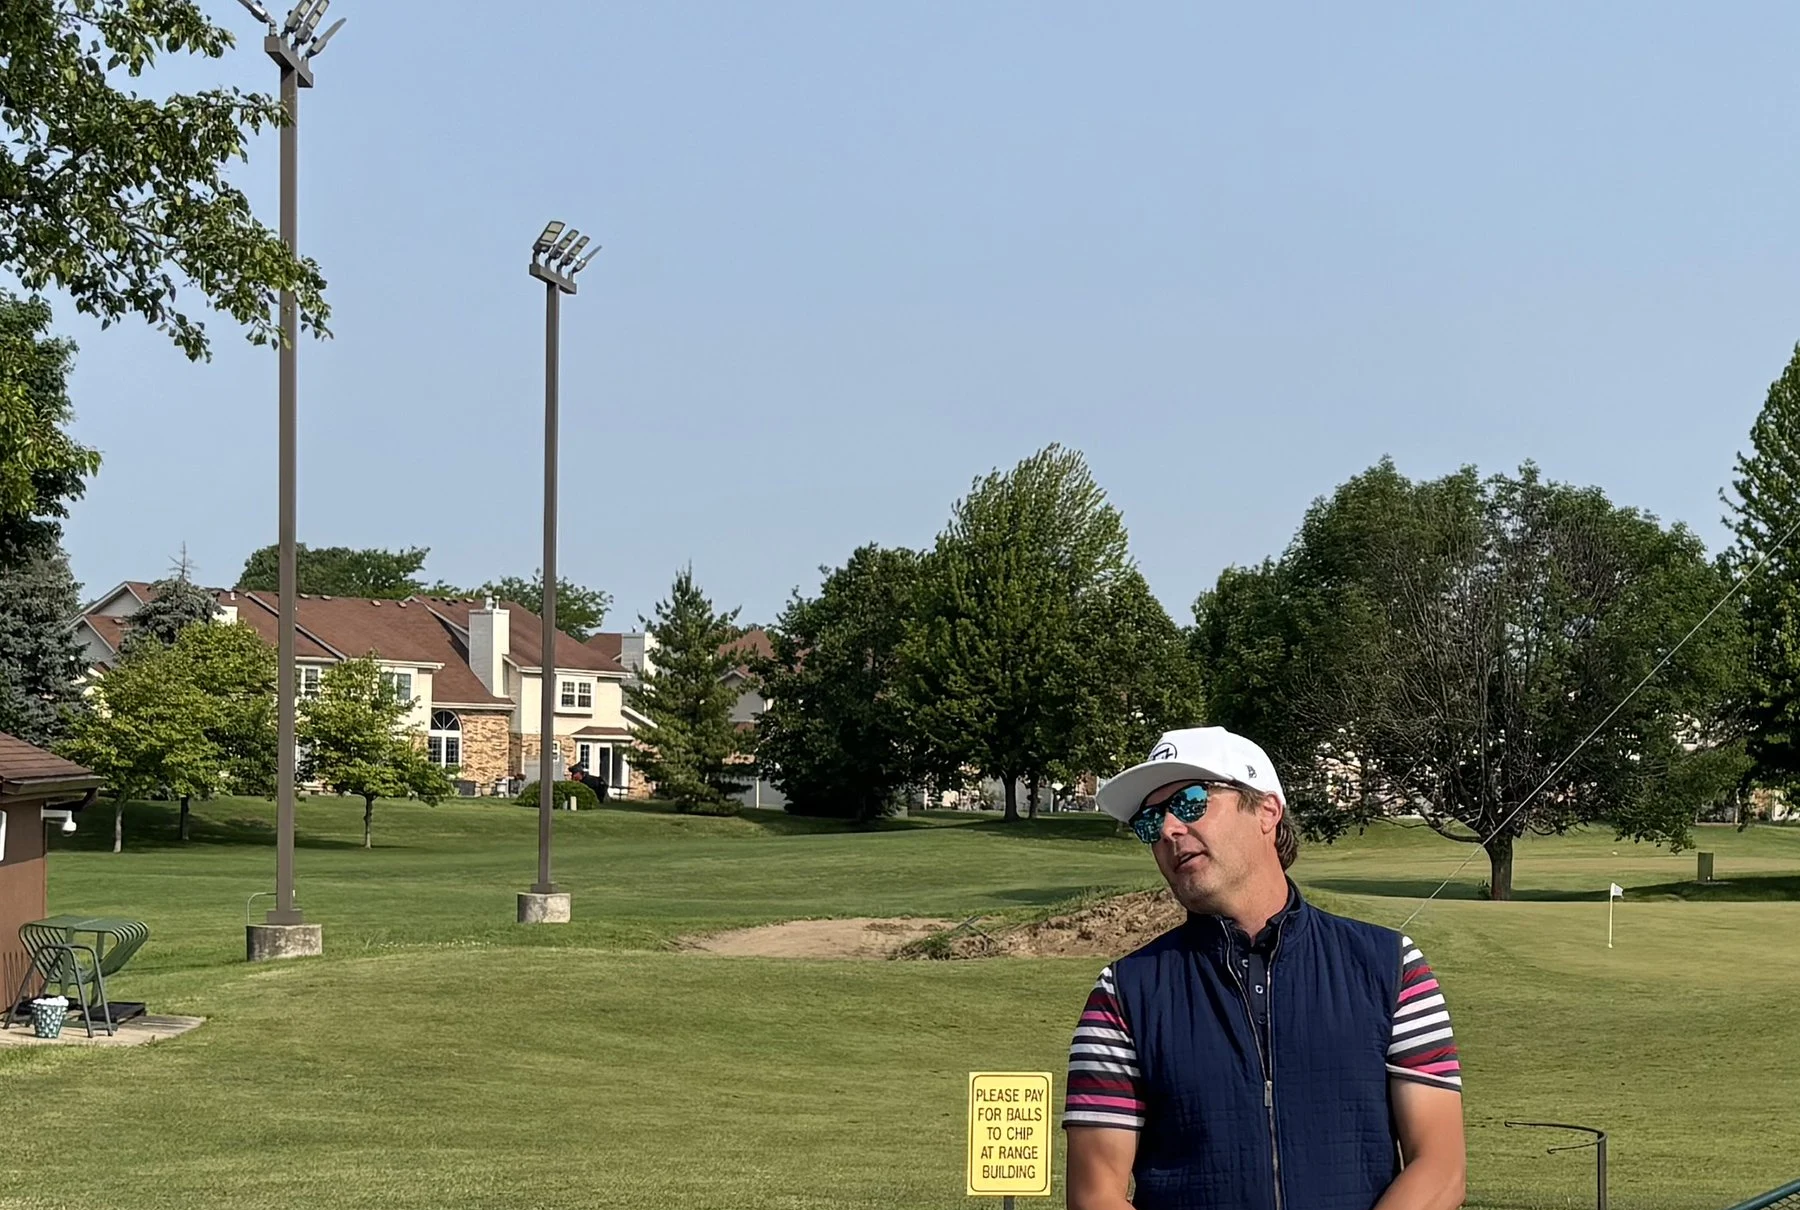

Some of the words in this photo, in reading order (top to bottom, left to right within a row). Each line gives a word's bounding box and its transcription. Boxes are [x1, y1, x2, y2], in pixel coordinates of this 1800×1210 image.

[976, 1088, 1020, 1102] PLEASE
[1024, 1088, 1044, 1102] PAY
[977, 1107, 1002, 1121] FOR
[1006, 1107, 1042, 1121] BALLS
[986, 1126, 1002, 1141] TO
[1006, 1126, 1034, 1140] CHIP
[980, 1146, 994, 1159] AT
[998, 1146, 1039, 1160] RANGE
[982, 1164, 1036, 1179] BUILDING
